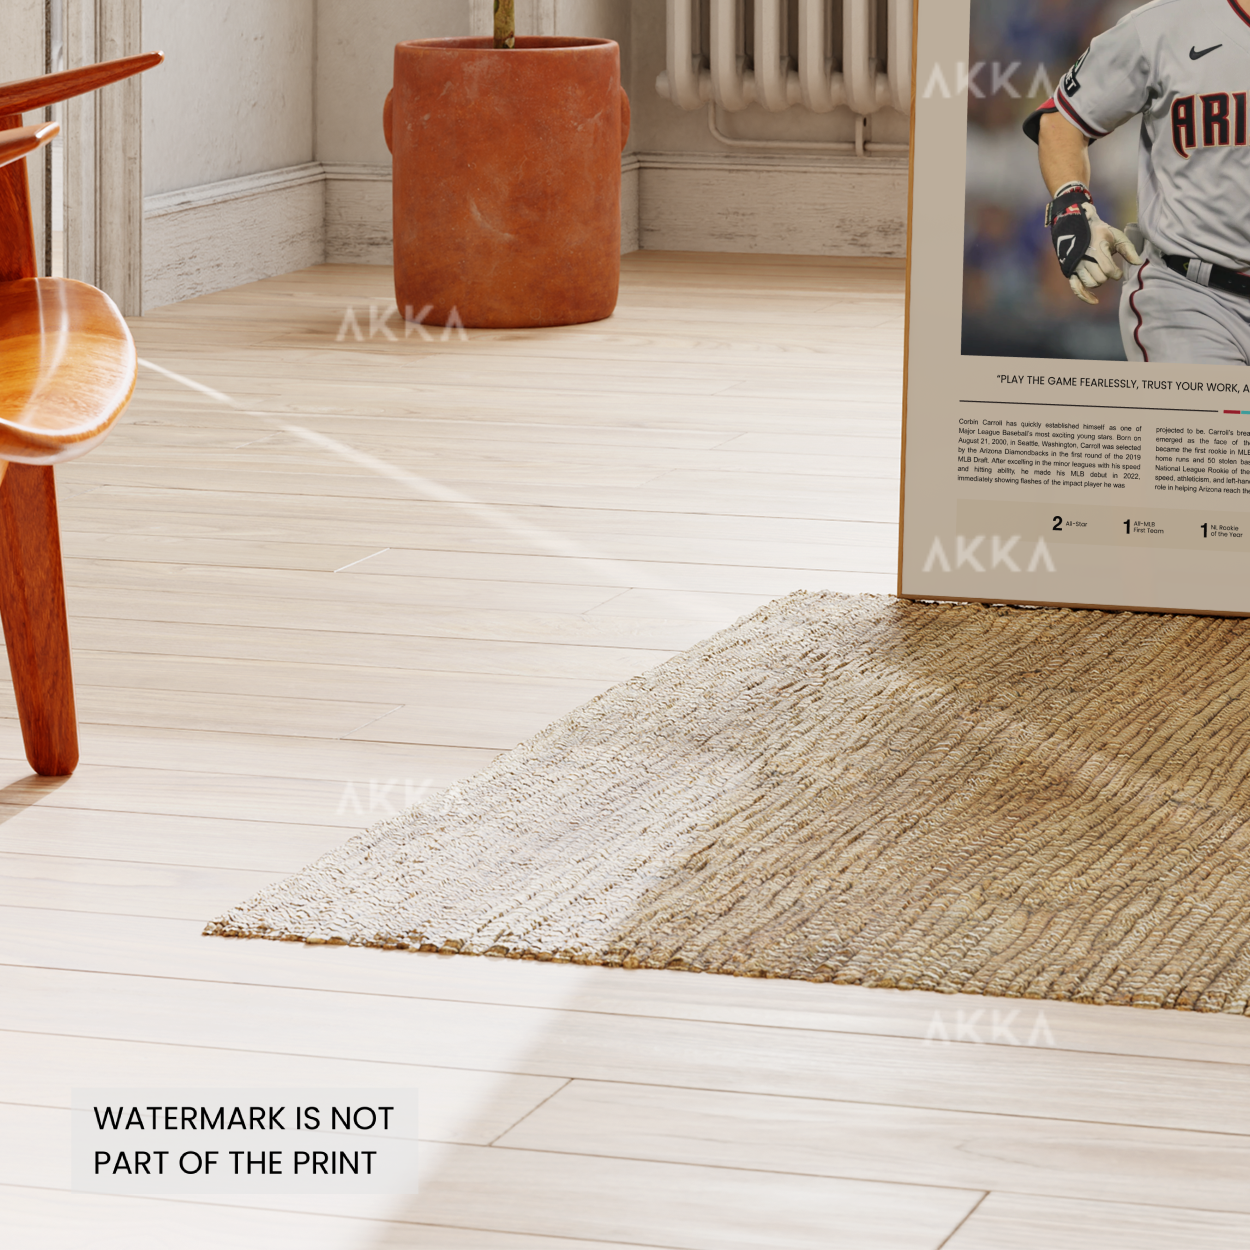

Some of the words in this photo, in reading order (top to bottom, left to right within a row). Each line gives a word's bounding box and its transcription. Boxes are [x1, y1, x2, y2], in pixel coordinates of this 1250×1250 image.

[1026, 375, 1044, 385] THE
[1047, 376, 1077, 386] GAME
[1079, 377, 1139, 389] FEARLESSLY,
[1141, 379, 1172, 390] TRUST
[1175, 381, 1203, 391] YOUR
[1206, 382, 1240, 393] WORK,
[958, 417, 978, 425] Corbin
[982, 418, 1002, 426] Carroll
[1020, 421, 1041, 429] quickly
[1155, 426, 1184, 435] projected
[1208, 428, 1233, 436] Carroll's
[1051, 515, 1063, 531] 2
[1122, 518, 1130, 534] 1
[1200, 522, 1207, 538] 1
